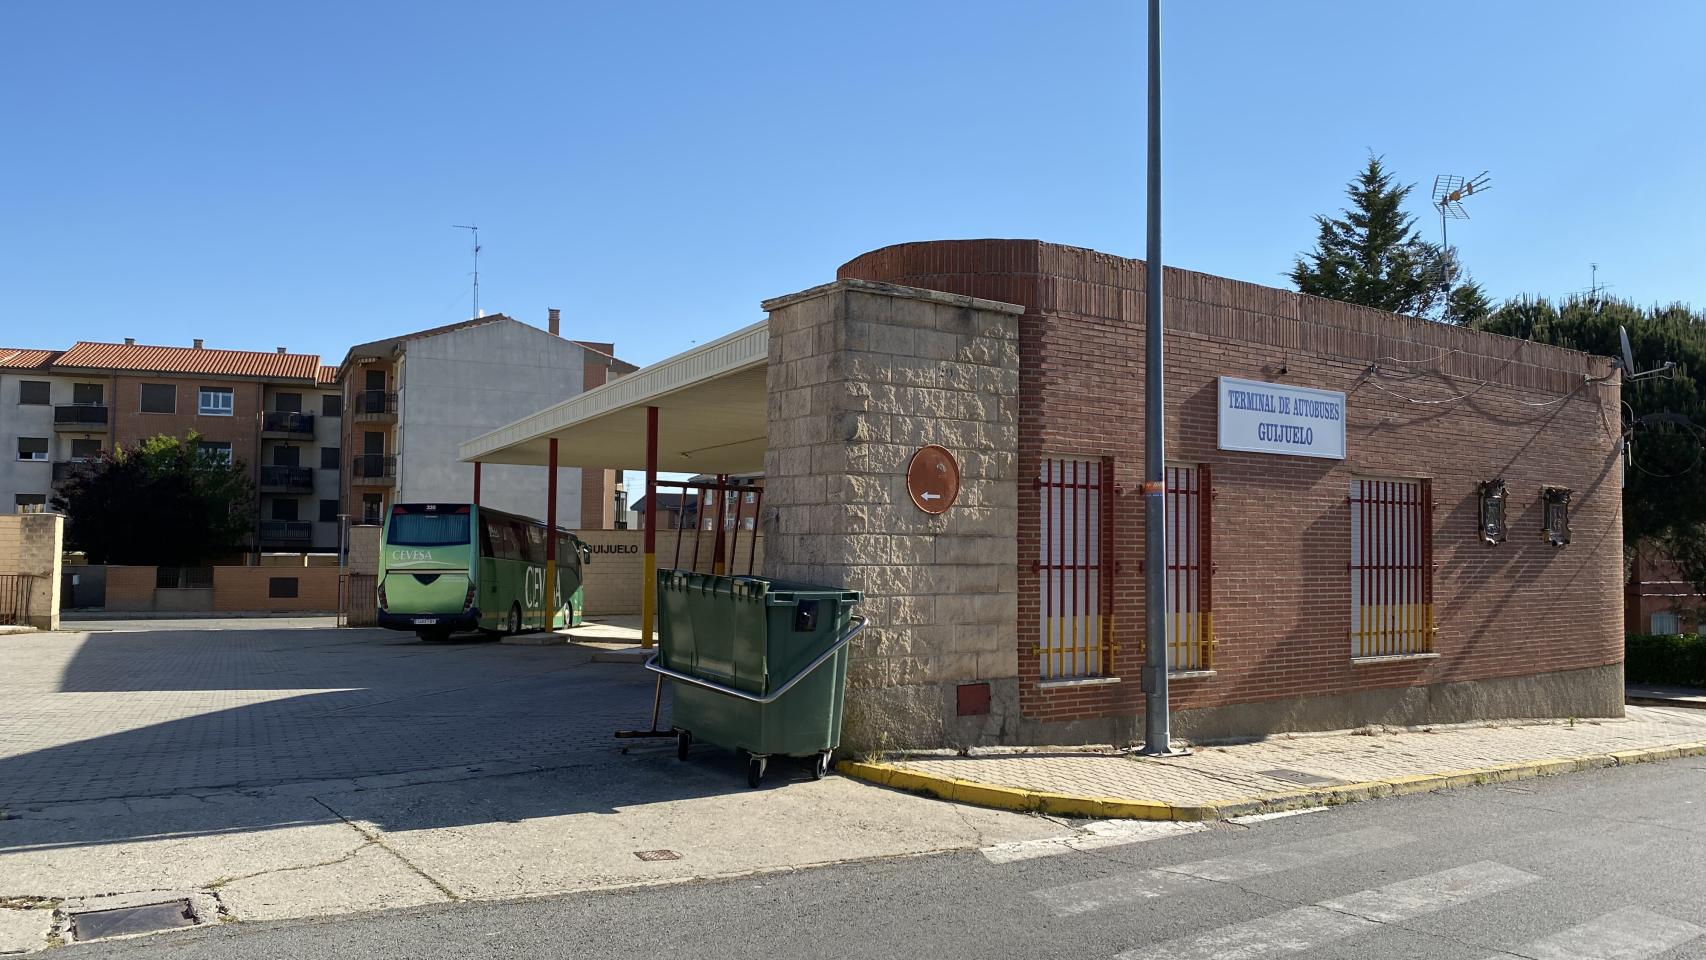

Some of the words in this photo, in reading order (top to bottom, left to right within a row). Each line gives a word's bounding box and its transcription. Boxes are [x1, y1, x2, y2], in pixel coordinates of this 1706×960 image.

[1228, 390, 1276, 413] TERMINAL
[1279, 397, 1290, 415] DE
[1293, 398, 1340, 420] AUTOBUSES
[1258, 423, 1313, 445] GUIJUELO
[392, 550, 432, 560] CEVESA
[525, 566, 562, 608] CEVA
